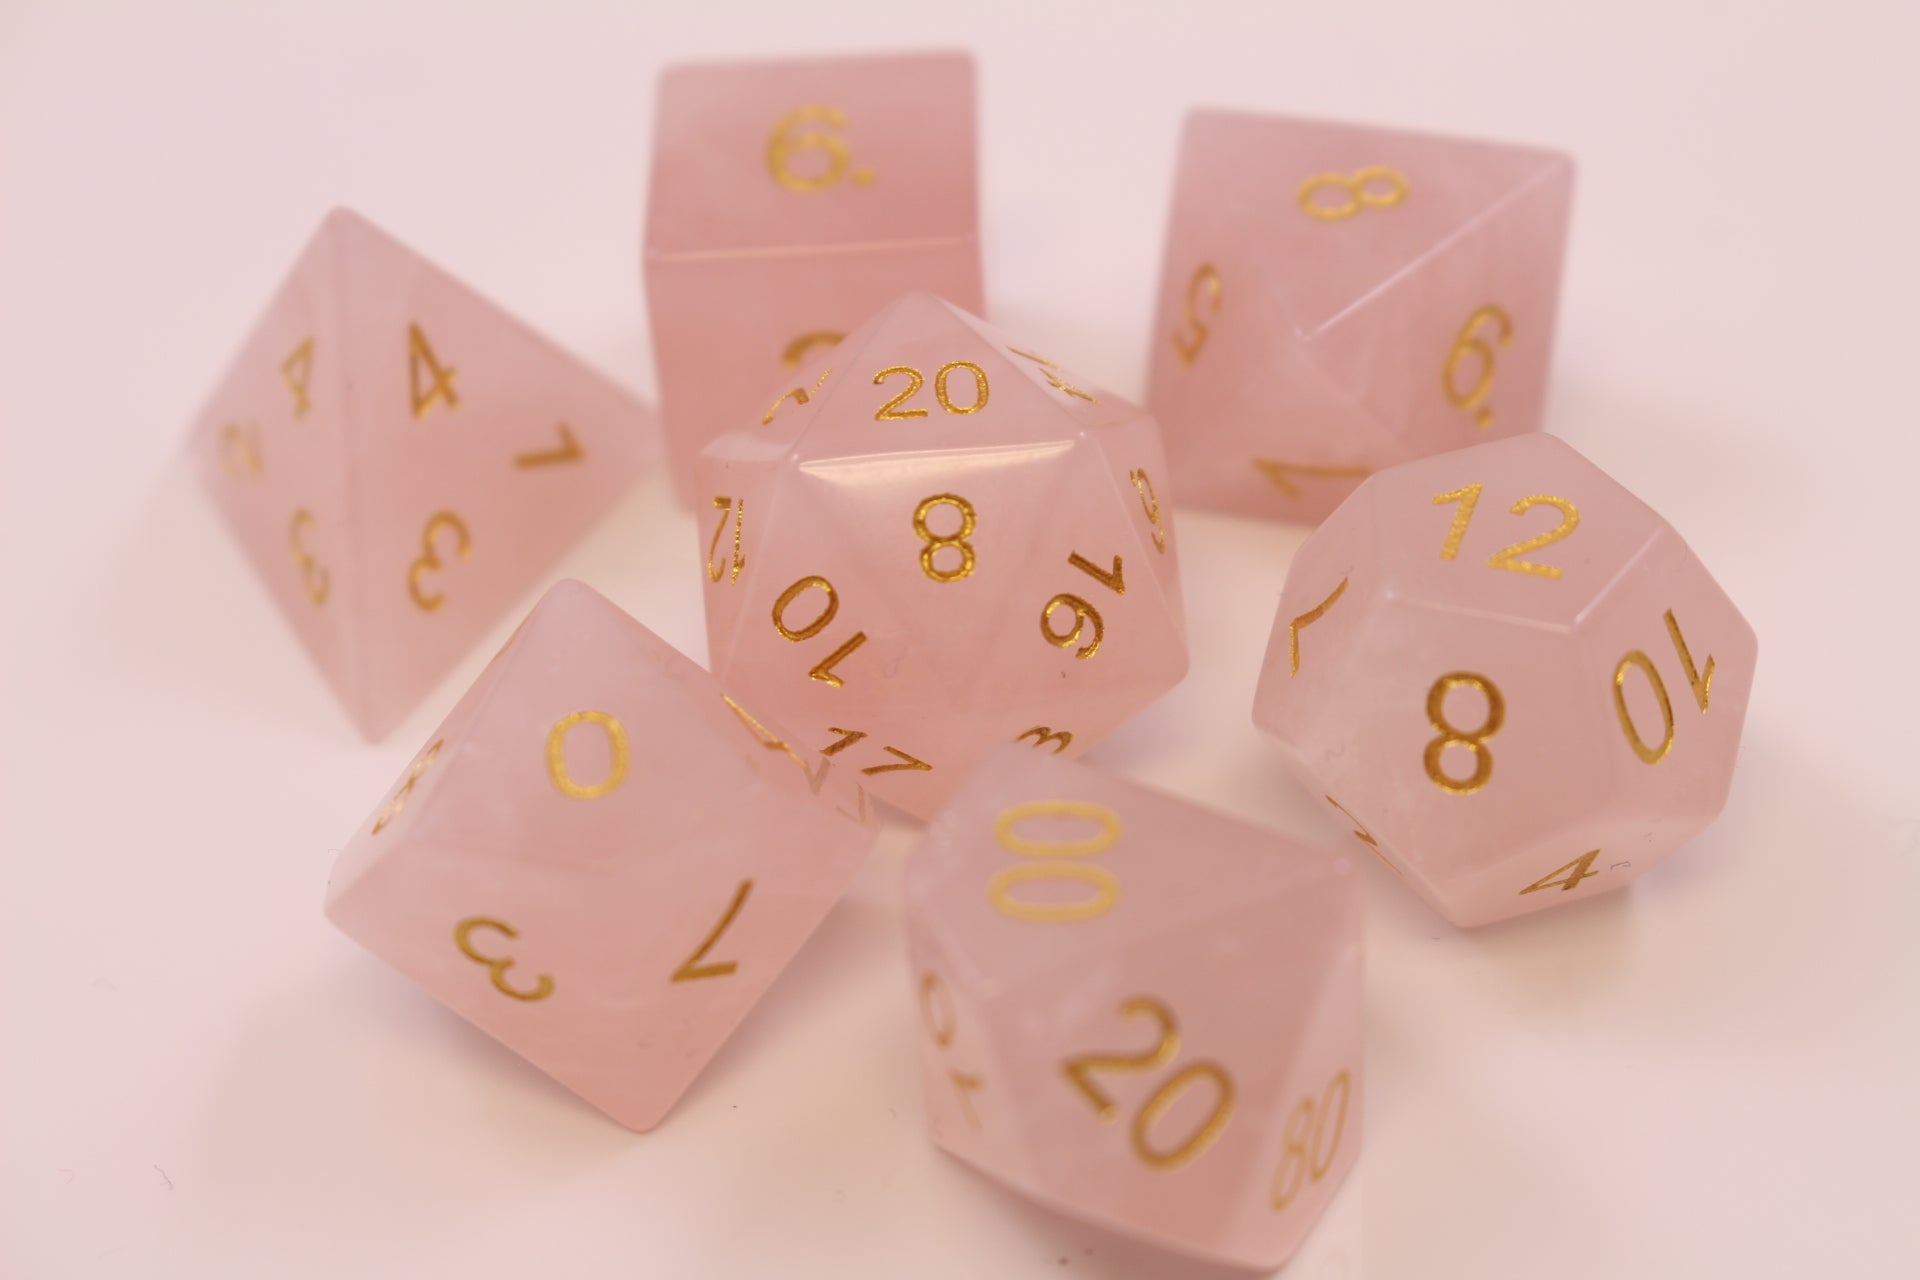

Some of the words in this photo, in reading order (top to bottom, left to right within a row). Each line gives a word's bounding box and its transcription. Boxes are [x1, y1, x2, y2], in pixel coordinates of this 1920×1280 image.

[1298, 165, 1410, 222] 8
[1172, 262, 1222, 370] 5
[281, 336, 314, 423] 4
[408, 322, 460, 420] 4
[872, 360, 990, 421] 20
[515, 421, 584, 471] 1
[288, 508, 332, 606] 3
[408, 511, 472, 613] 3
[708, 496, 746, 586] 12
[912, 492, 977, 583] 8
[1432, 482, 1581, 581] 12
[771, 575, 868, 689] 10
[1040, 550, 1126, 660] 16
[1289, 576, 1349, 677] 7
[1423, 670, 1506, 796] 8
[1612, 608, 1716, 766] 10
[545, 708, 630, 801] 0
[820, 726, 933, 777] 17
[1014, 725, 1074, 755] 3
[988, 801, 1122, 924] 00
[1519, 848, 1600, 896] 4
[453, 915, 556, 1003] 3
[668, 878, 755, 985] 7
[1058, 993, 1237, 1172] 20
[1269, 1069, 1350, 1212] 80
